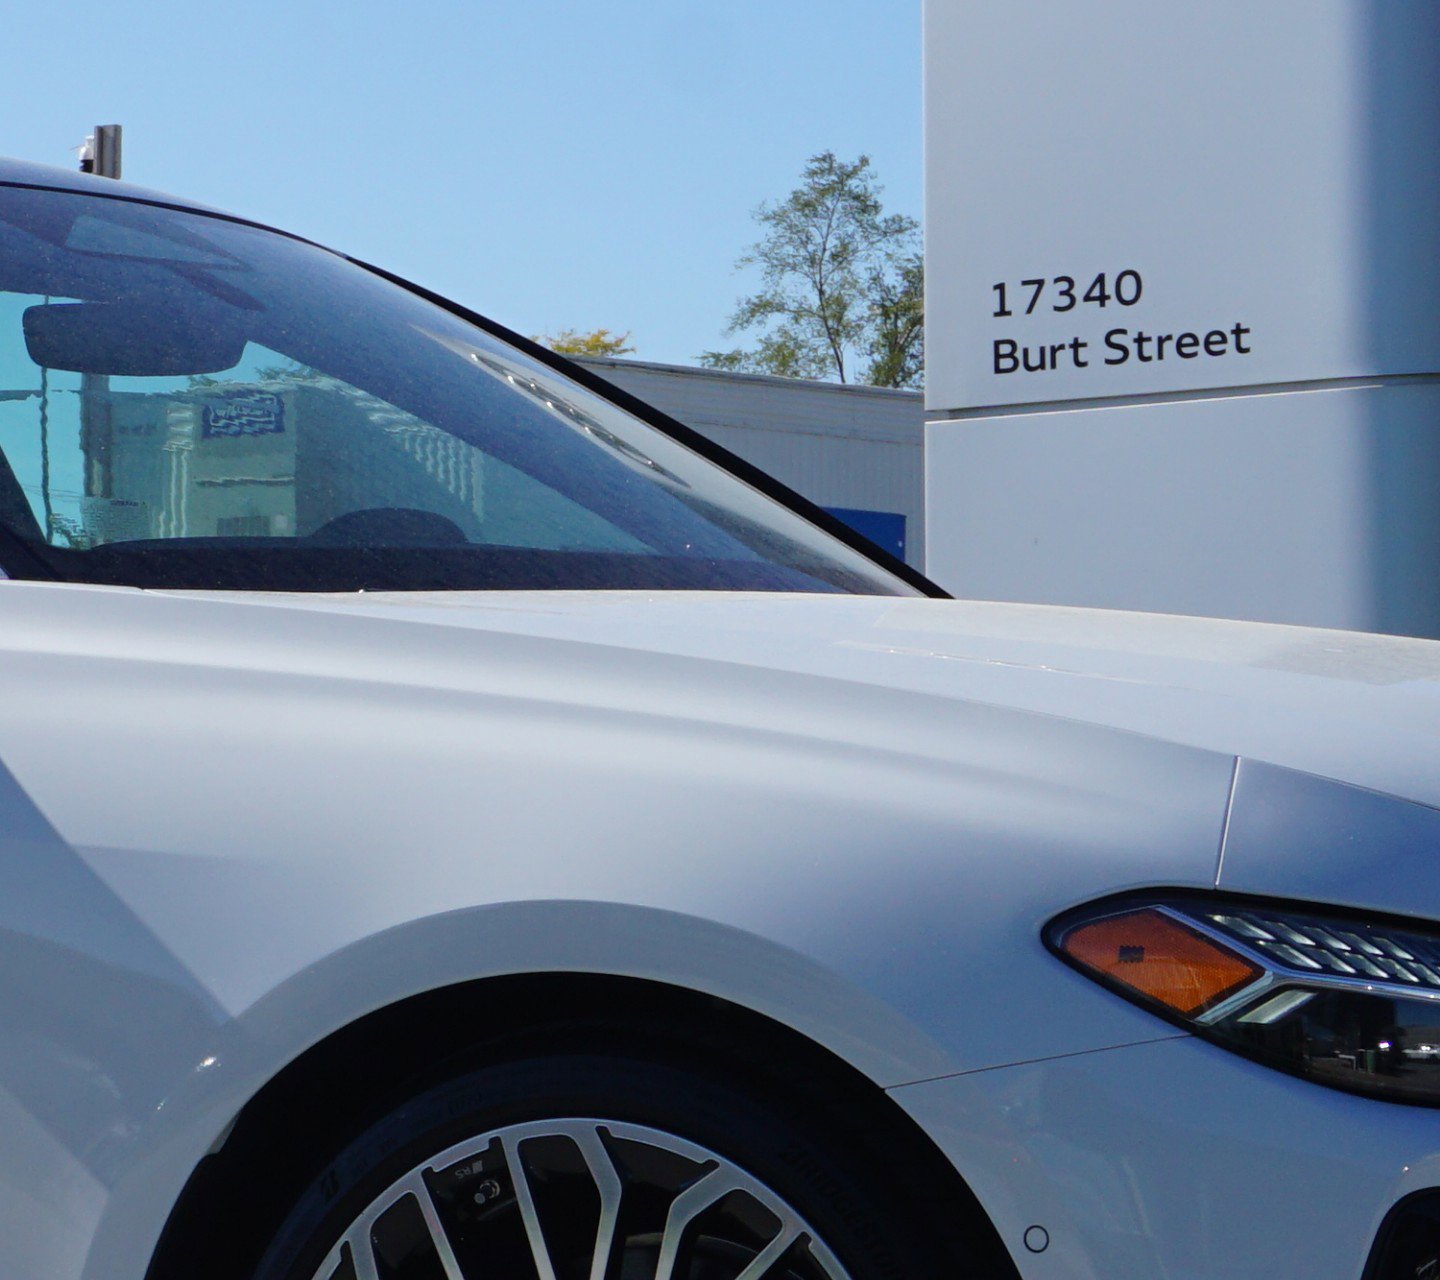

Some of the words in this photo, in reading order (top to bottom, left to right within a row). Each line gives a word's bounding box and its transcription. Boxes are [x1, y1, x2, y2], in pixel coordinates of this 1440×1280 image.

[992, 269, 1143, 318] 17340
[993, 336, 1089, 375] Burt
[1104, 322, 1251, 366] Street
